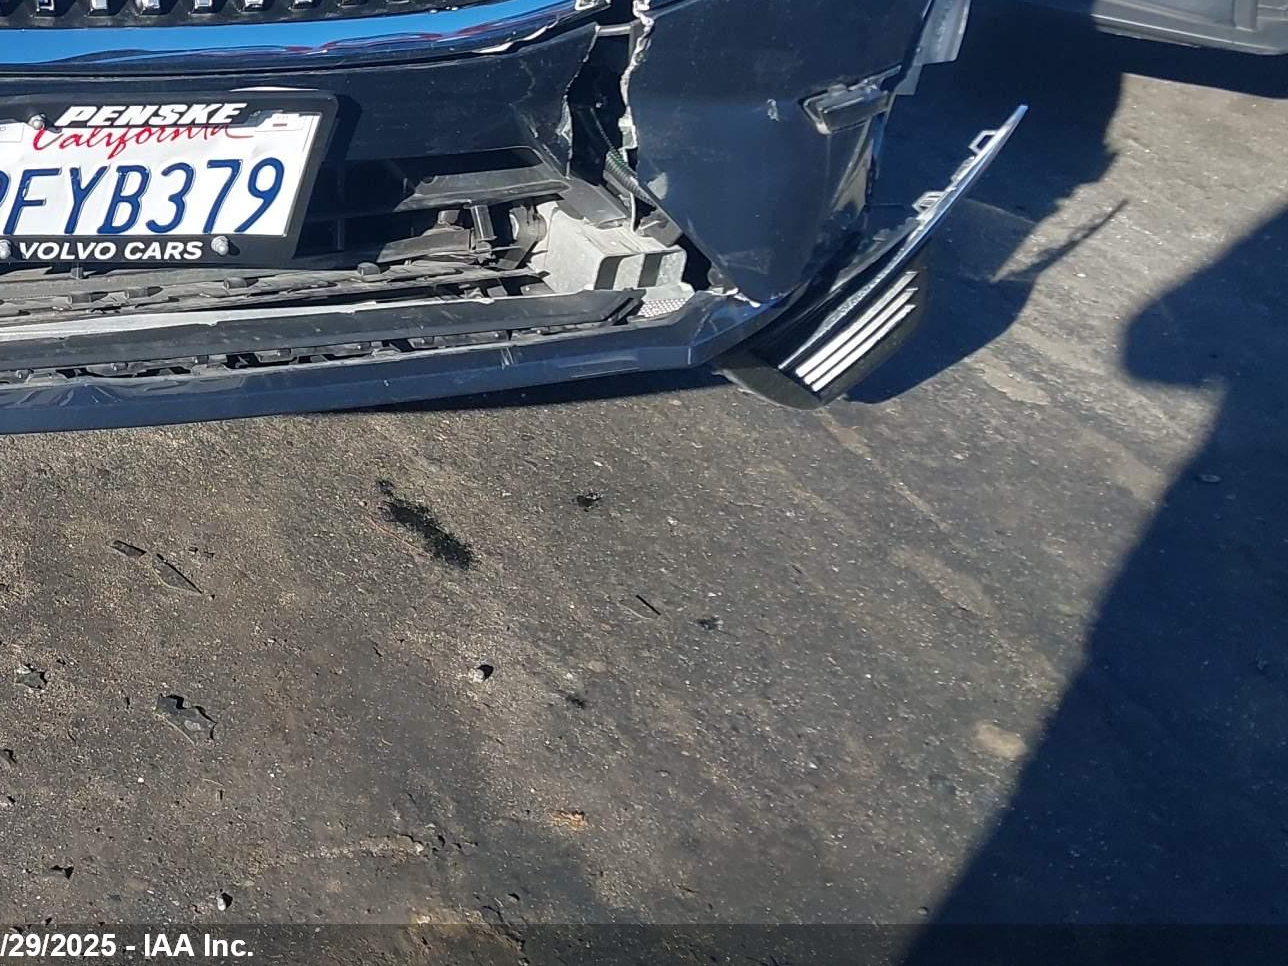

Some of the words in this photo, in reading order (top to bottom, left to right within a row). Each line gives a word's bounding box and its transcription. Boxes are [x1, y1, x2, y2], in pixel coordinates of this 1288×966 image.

[54, 102, 248, 127] PENSKE
[32, 123, 254, 160] California
[19, 241, 117, 260] VOLVO
[124, 241, 203, 260] CARS
